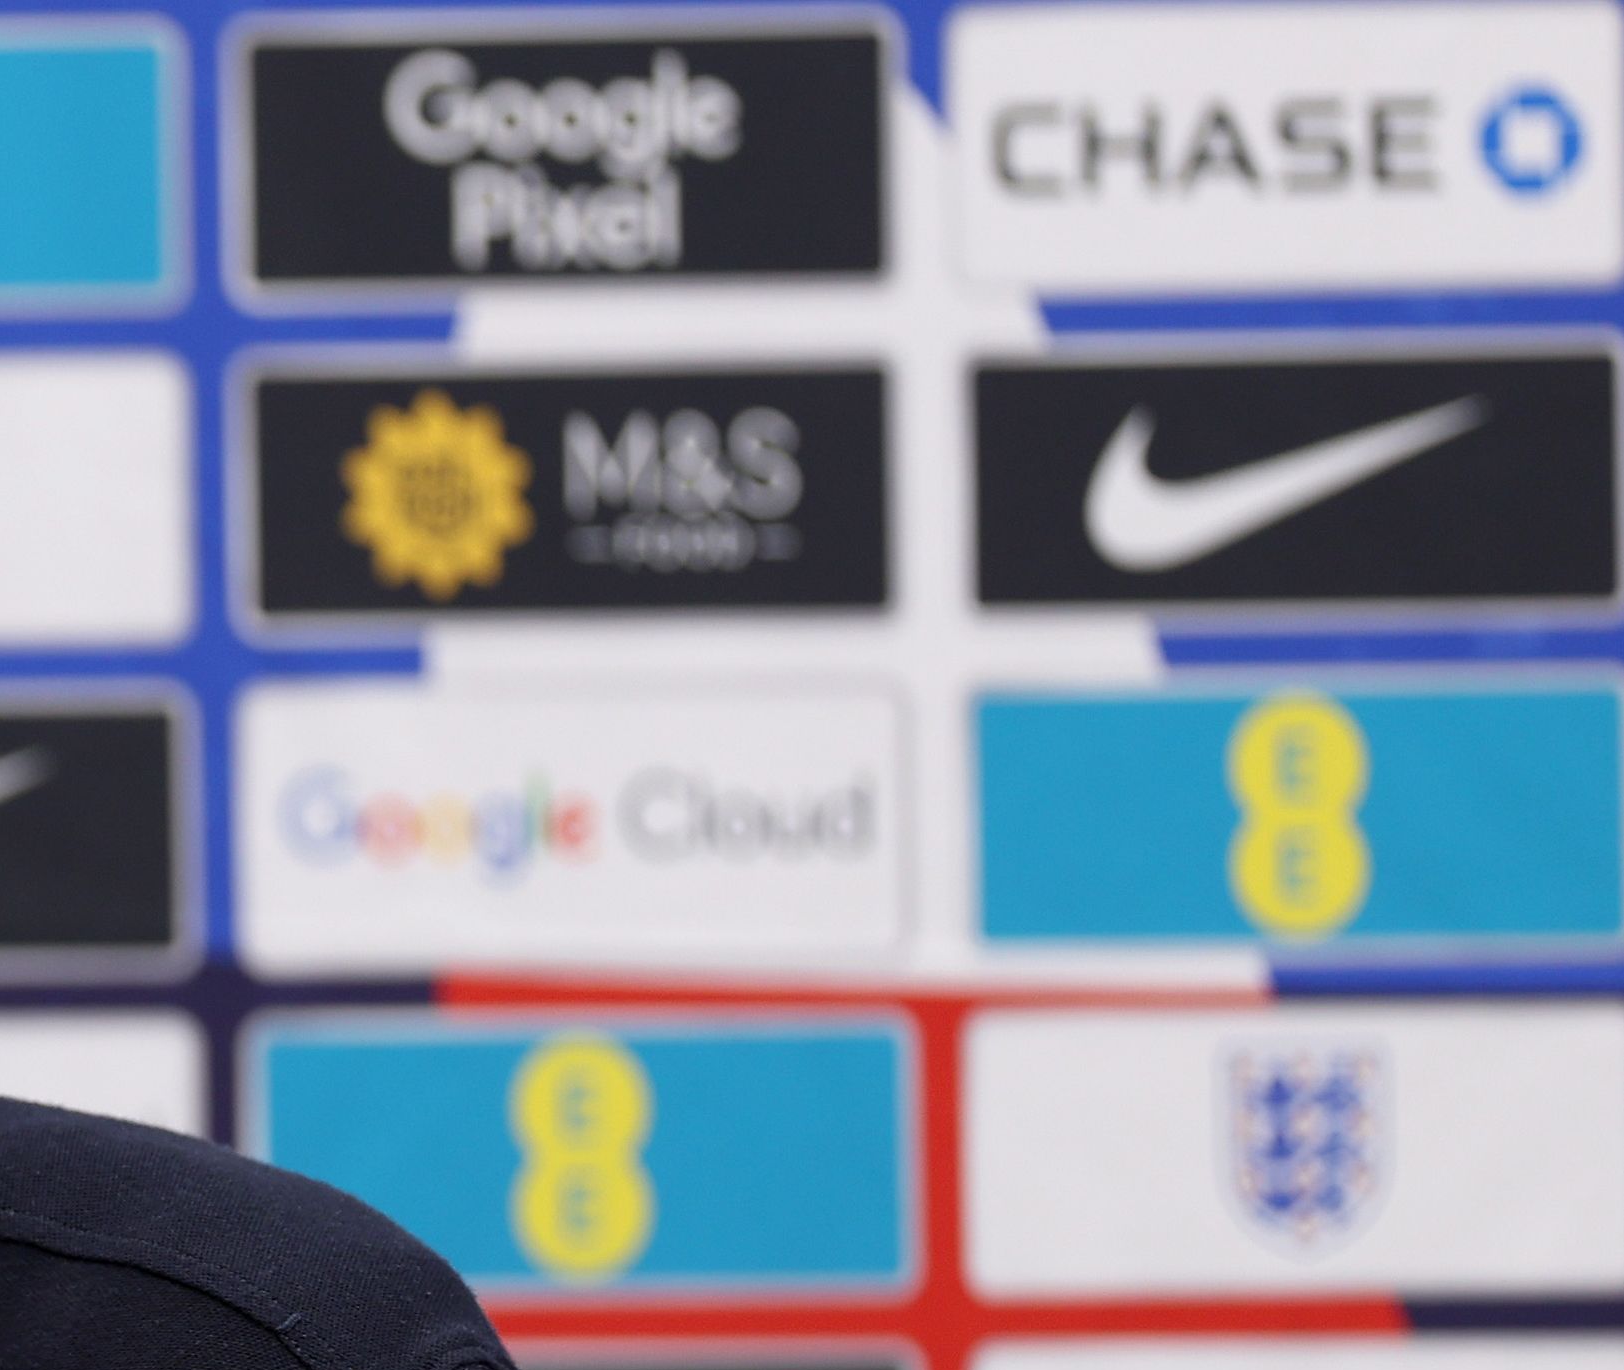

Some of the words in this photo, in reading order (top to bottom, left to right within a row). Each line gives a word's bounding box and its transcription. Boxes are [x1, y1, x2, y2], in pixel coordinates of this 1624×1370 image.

[383, 46, 743, 180] Google
[990, 93, 1441, 200] CHASE
[451, 161, 682, 269] Pixel
[561, 404, 805, 522] M&S
[277, 760, 597, 888] Google
[615, 760, 877, 865] Cloud
